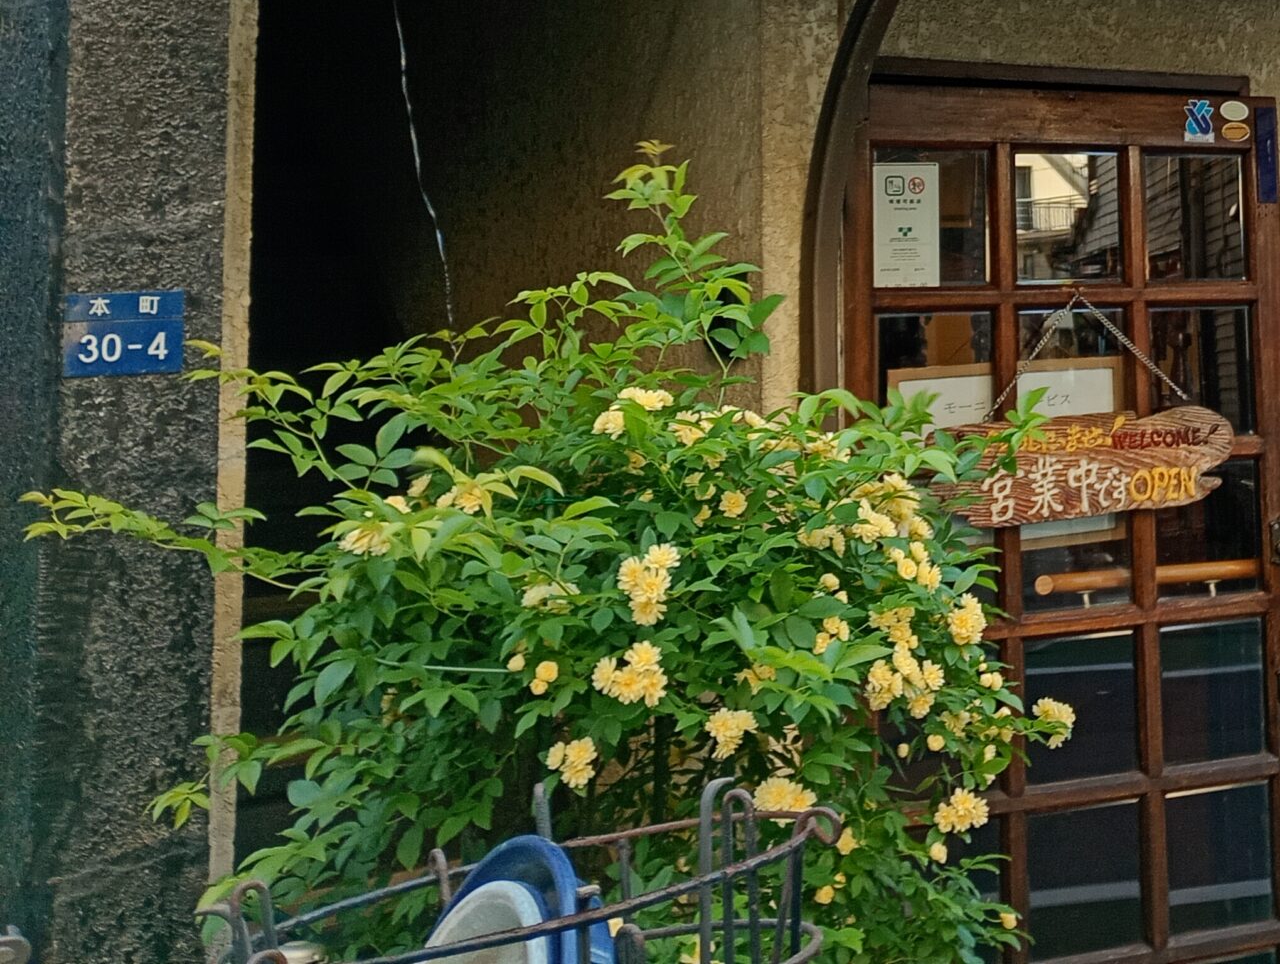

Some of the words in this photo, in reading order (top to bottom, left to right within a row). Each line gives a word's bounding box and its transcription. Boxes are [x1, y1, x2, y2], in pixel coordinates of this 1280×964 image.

[88, 296, 161, 316] 本町
[78, 332, 168, 363] 30-4
[1129, 466, 1198, 502] OPEN
